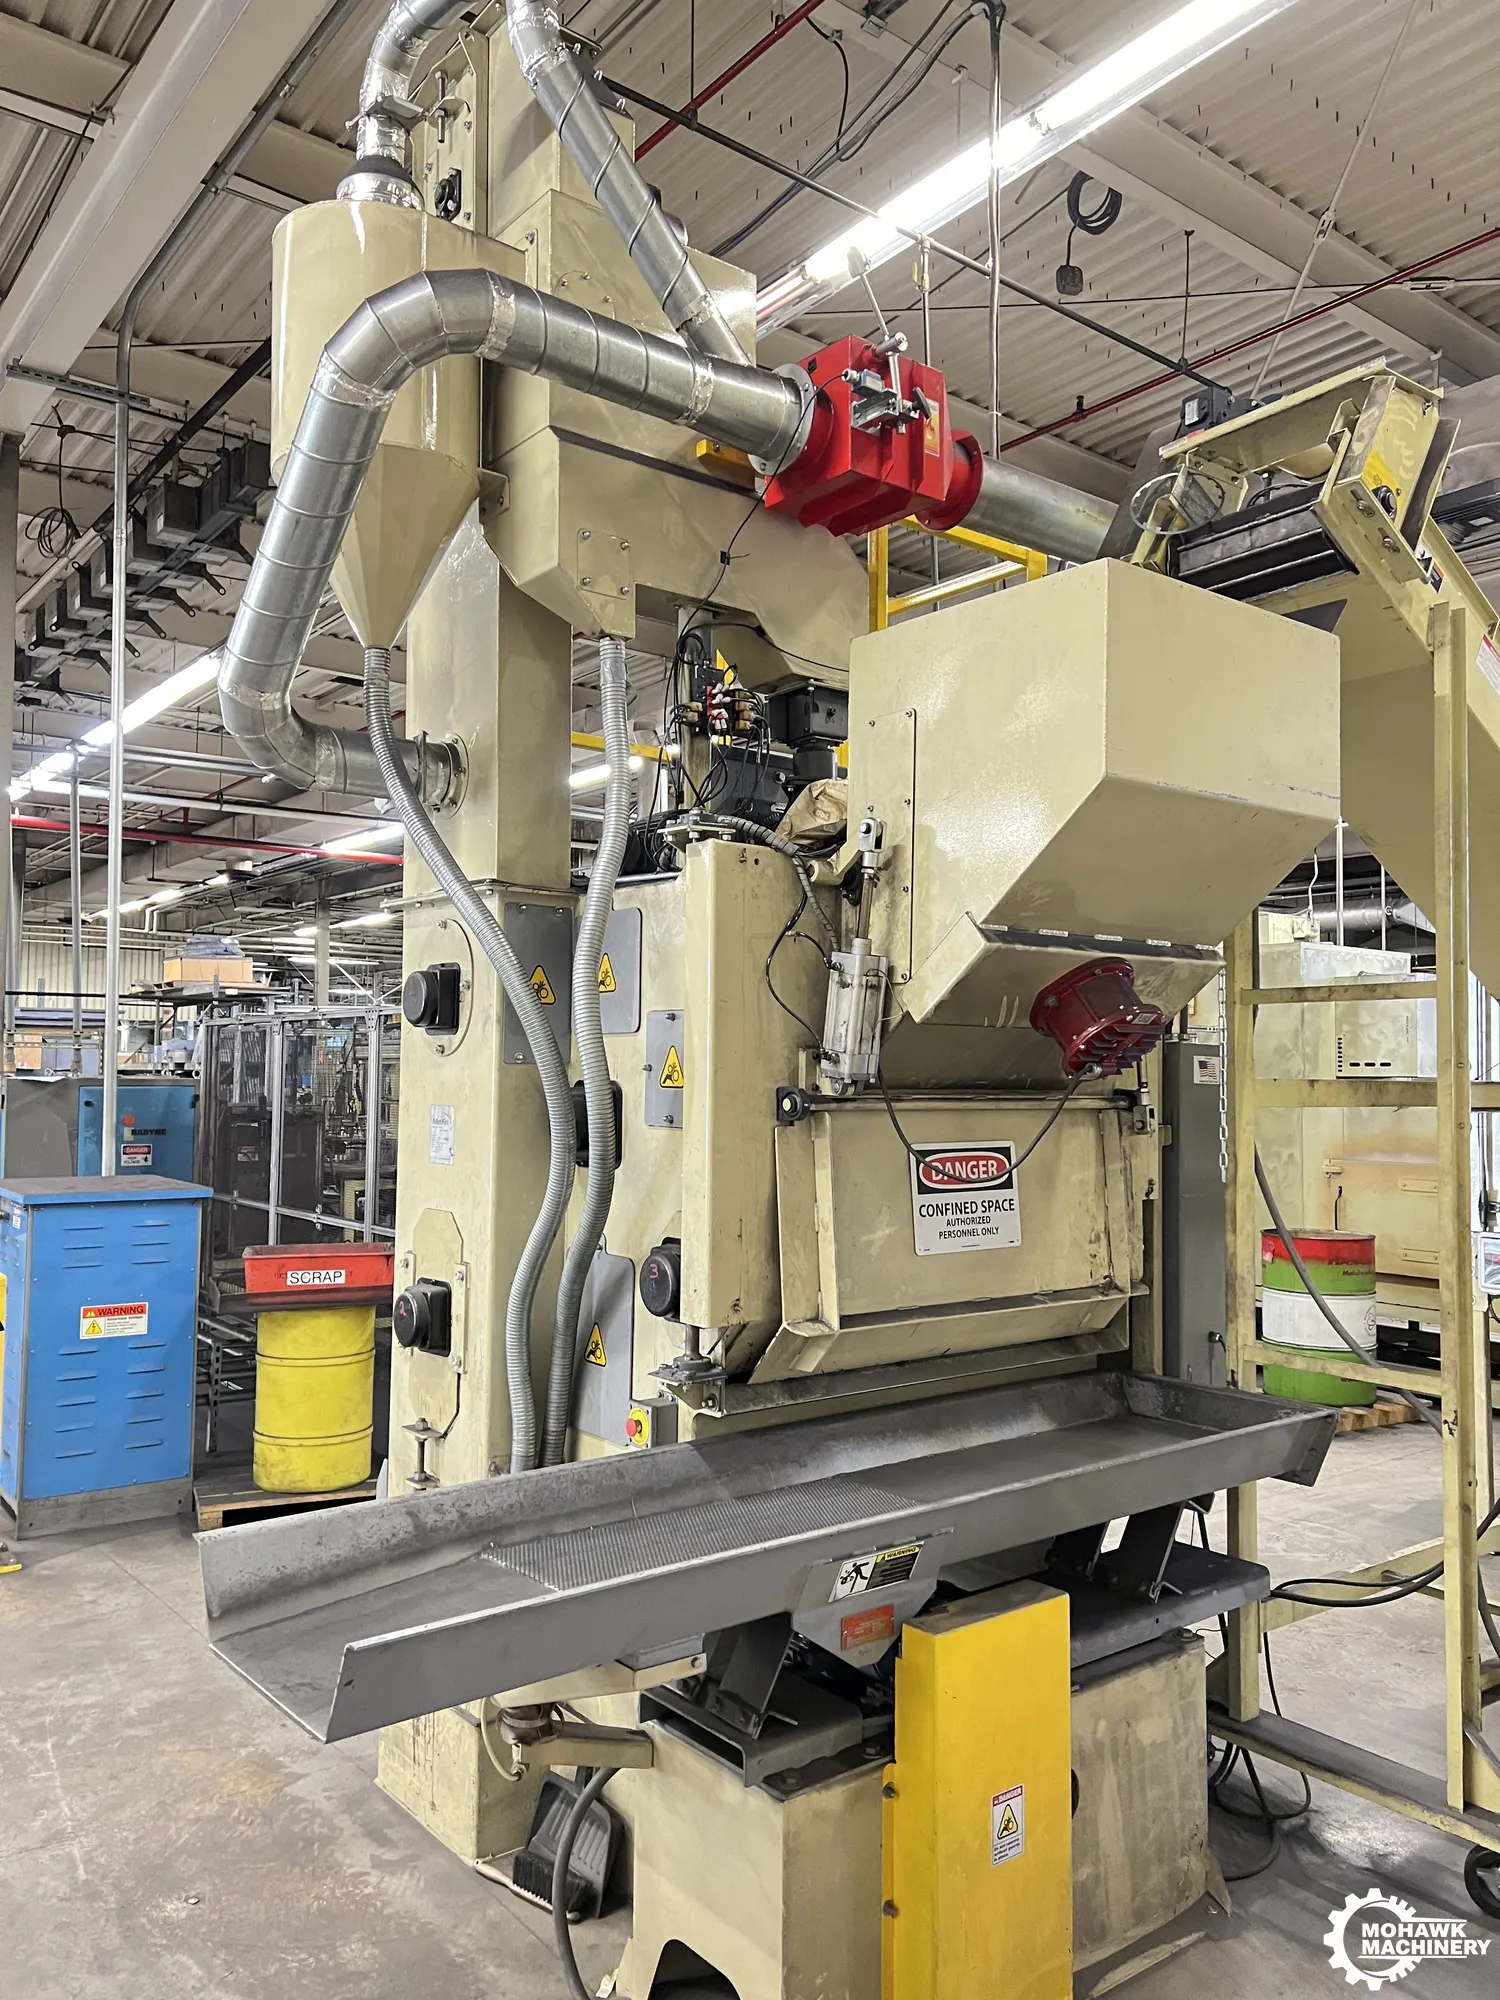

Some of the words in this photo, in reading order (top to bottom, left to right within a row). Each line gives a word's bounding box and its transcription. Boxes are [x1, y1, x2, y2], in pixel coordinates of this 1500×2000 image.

[931, 1159, 998, 1181] DANGER
[918, 1200, 979, 1218] CONFINED
[980, 1198, 1015, 1214] SPACE
[946, 1215, 991, 1227] AUTHORIZED
[938, 1228, 980, 1240] PERSONNEL
[981, 1226, 1000, 1236] ONLY
[289, 1270, 343, 1285] SCRAP
[649, 1263, 659, 1279] 3
[97, 1305, 144, 1316] WARNING
[399, 1300, 407, 1317] 2
[886, 1546, 917, 1559] WARNING
[998, 1787, 1021, 1802] DANGER
